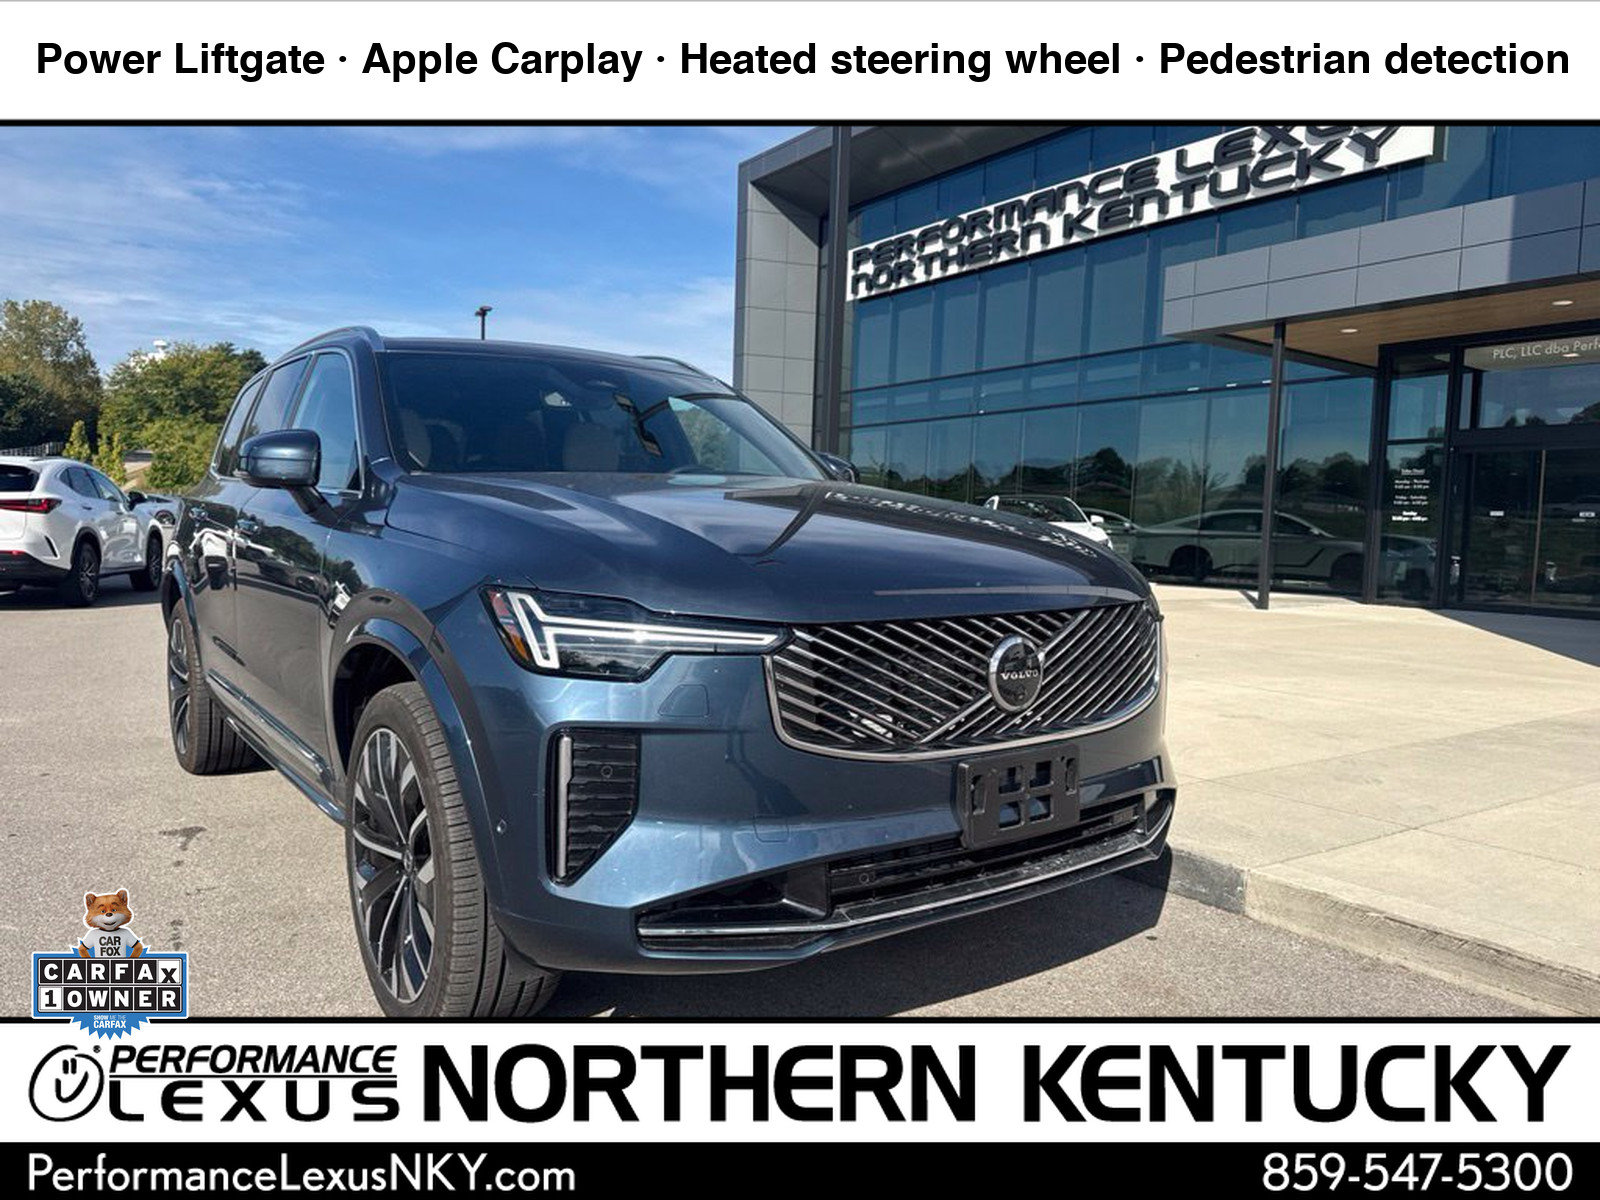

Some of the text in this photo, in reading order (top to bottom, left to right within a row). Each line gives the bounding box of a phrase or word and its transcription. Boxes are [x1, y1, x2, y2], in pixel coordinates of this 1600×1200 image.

[852, 126, 1400, 296] NORTHERN KENTUCKY
[852, 157, 1160, 272] PERFORMANCE
[1000, 670, 1038, 680] VOLVO
